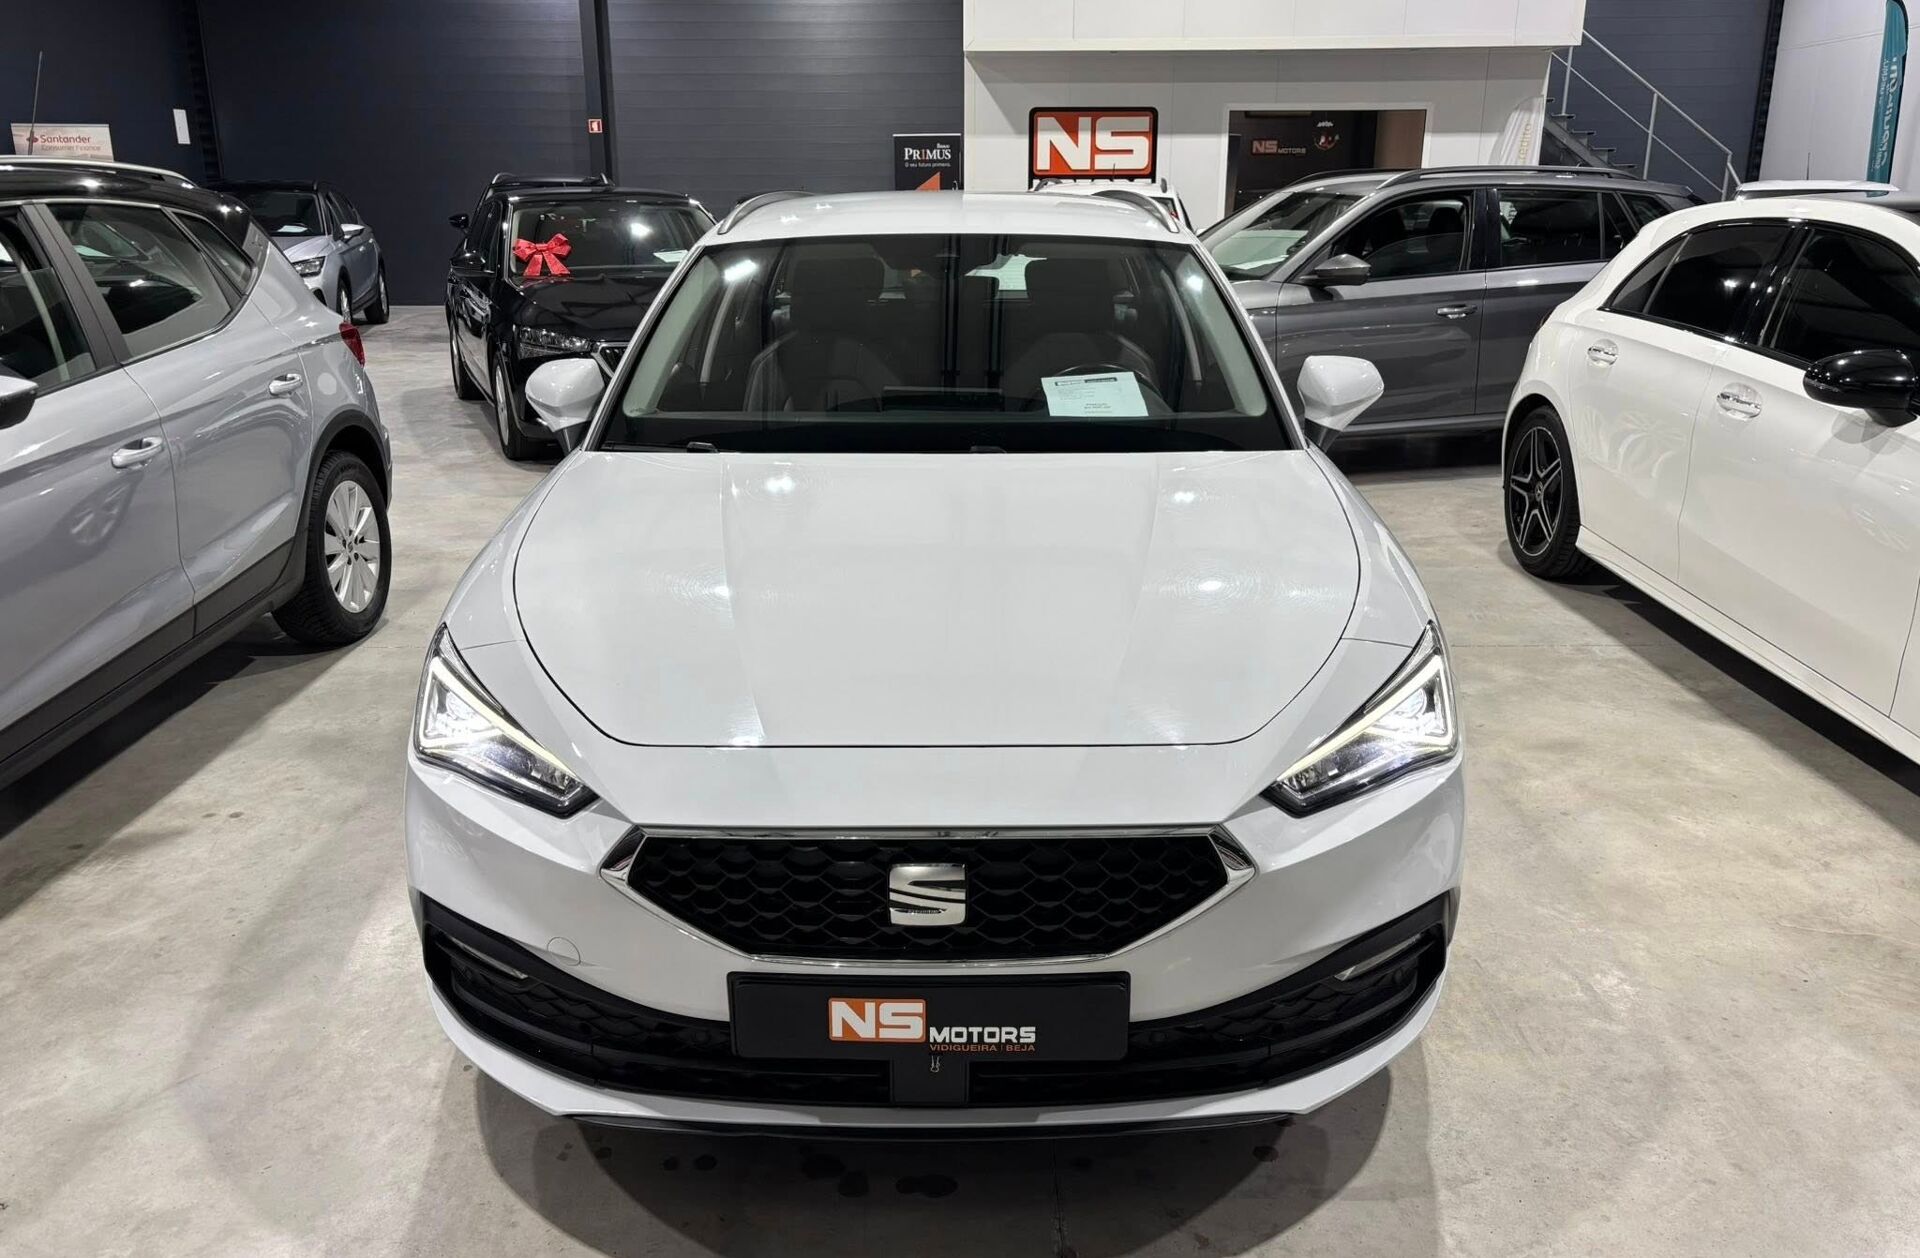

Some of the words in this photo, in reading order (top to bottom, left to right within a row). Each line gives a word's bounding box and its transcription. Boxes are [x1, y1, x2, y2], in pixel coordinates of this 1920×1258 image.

[40, 134, 91, 144] Santander
[1037, 116, 1150, 170] NS
[1252, 140, 1278, 153] NS
[831, 1001, 924, 1039] NS
[929, 1026, 1036, 1043] MOTORS
